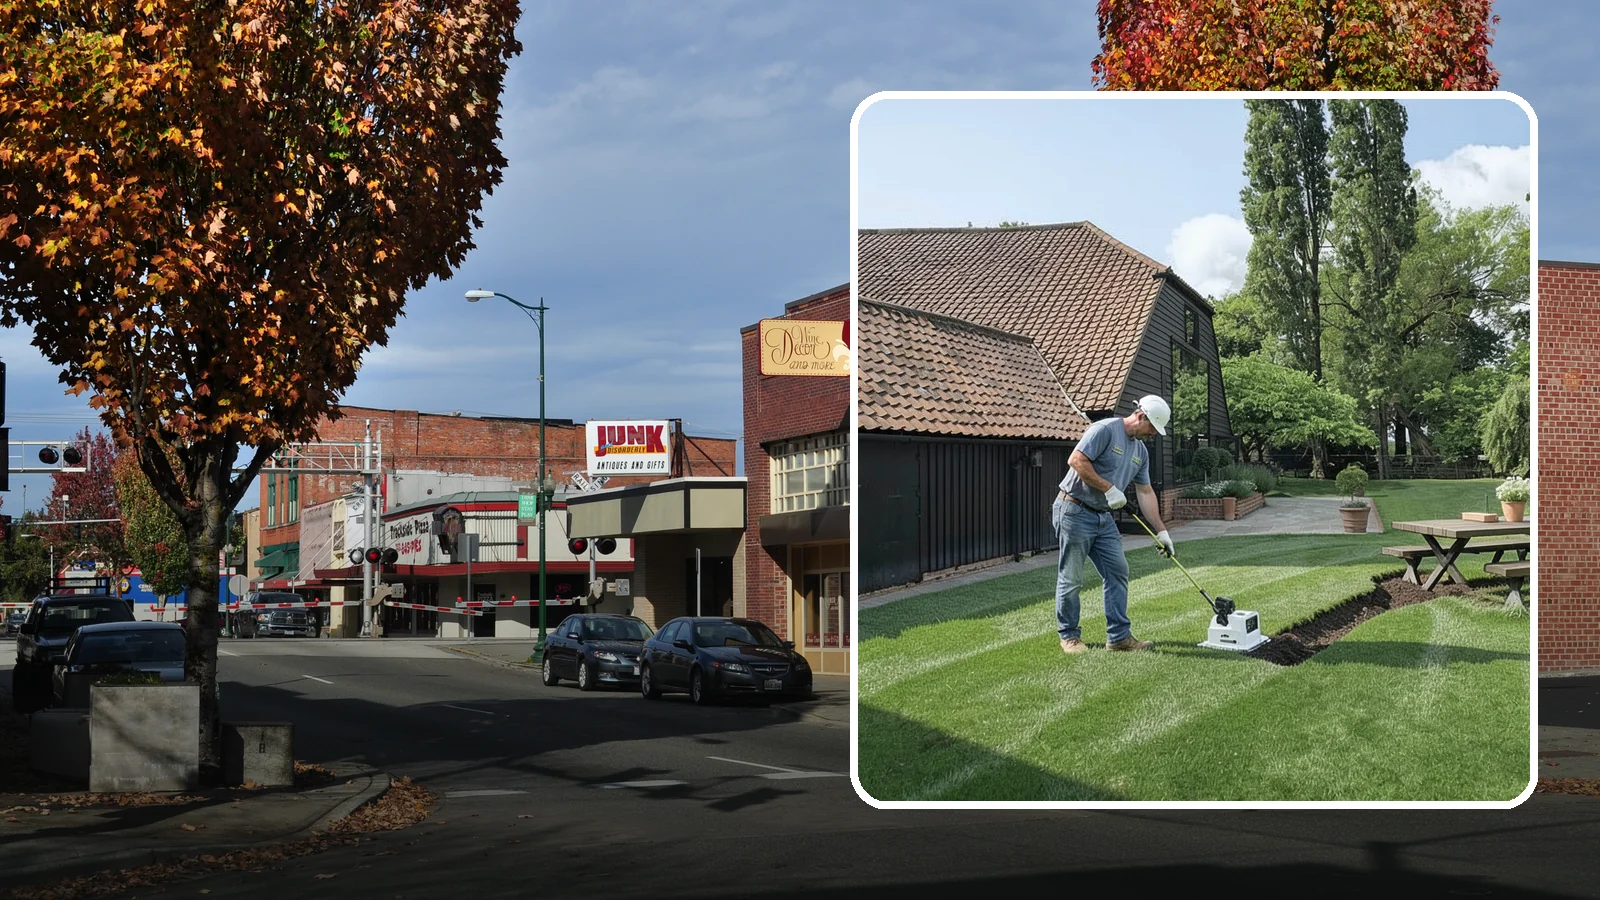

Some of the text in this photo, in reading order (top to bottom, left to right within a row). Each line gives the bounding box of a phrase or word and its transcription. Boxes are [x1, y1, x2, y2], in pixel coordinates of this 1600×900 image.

[765, 328, 831, 365] Decor
[595, 425, 664, 457] JUNK
[607, 446, 645, 454] DISORDERLY
[597, 460, 665, 470] ANTIQUES AND GIFTS
[415, 519, 429, 534] Pizza
